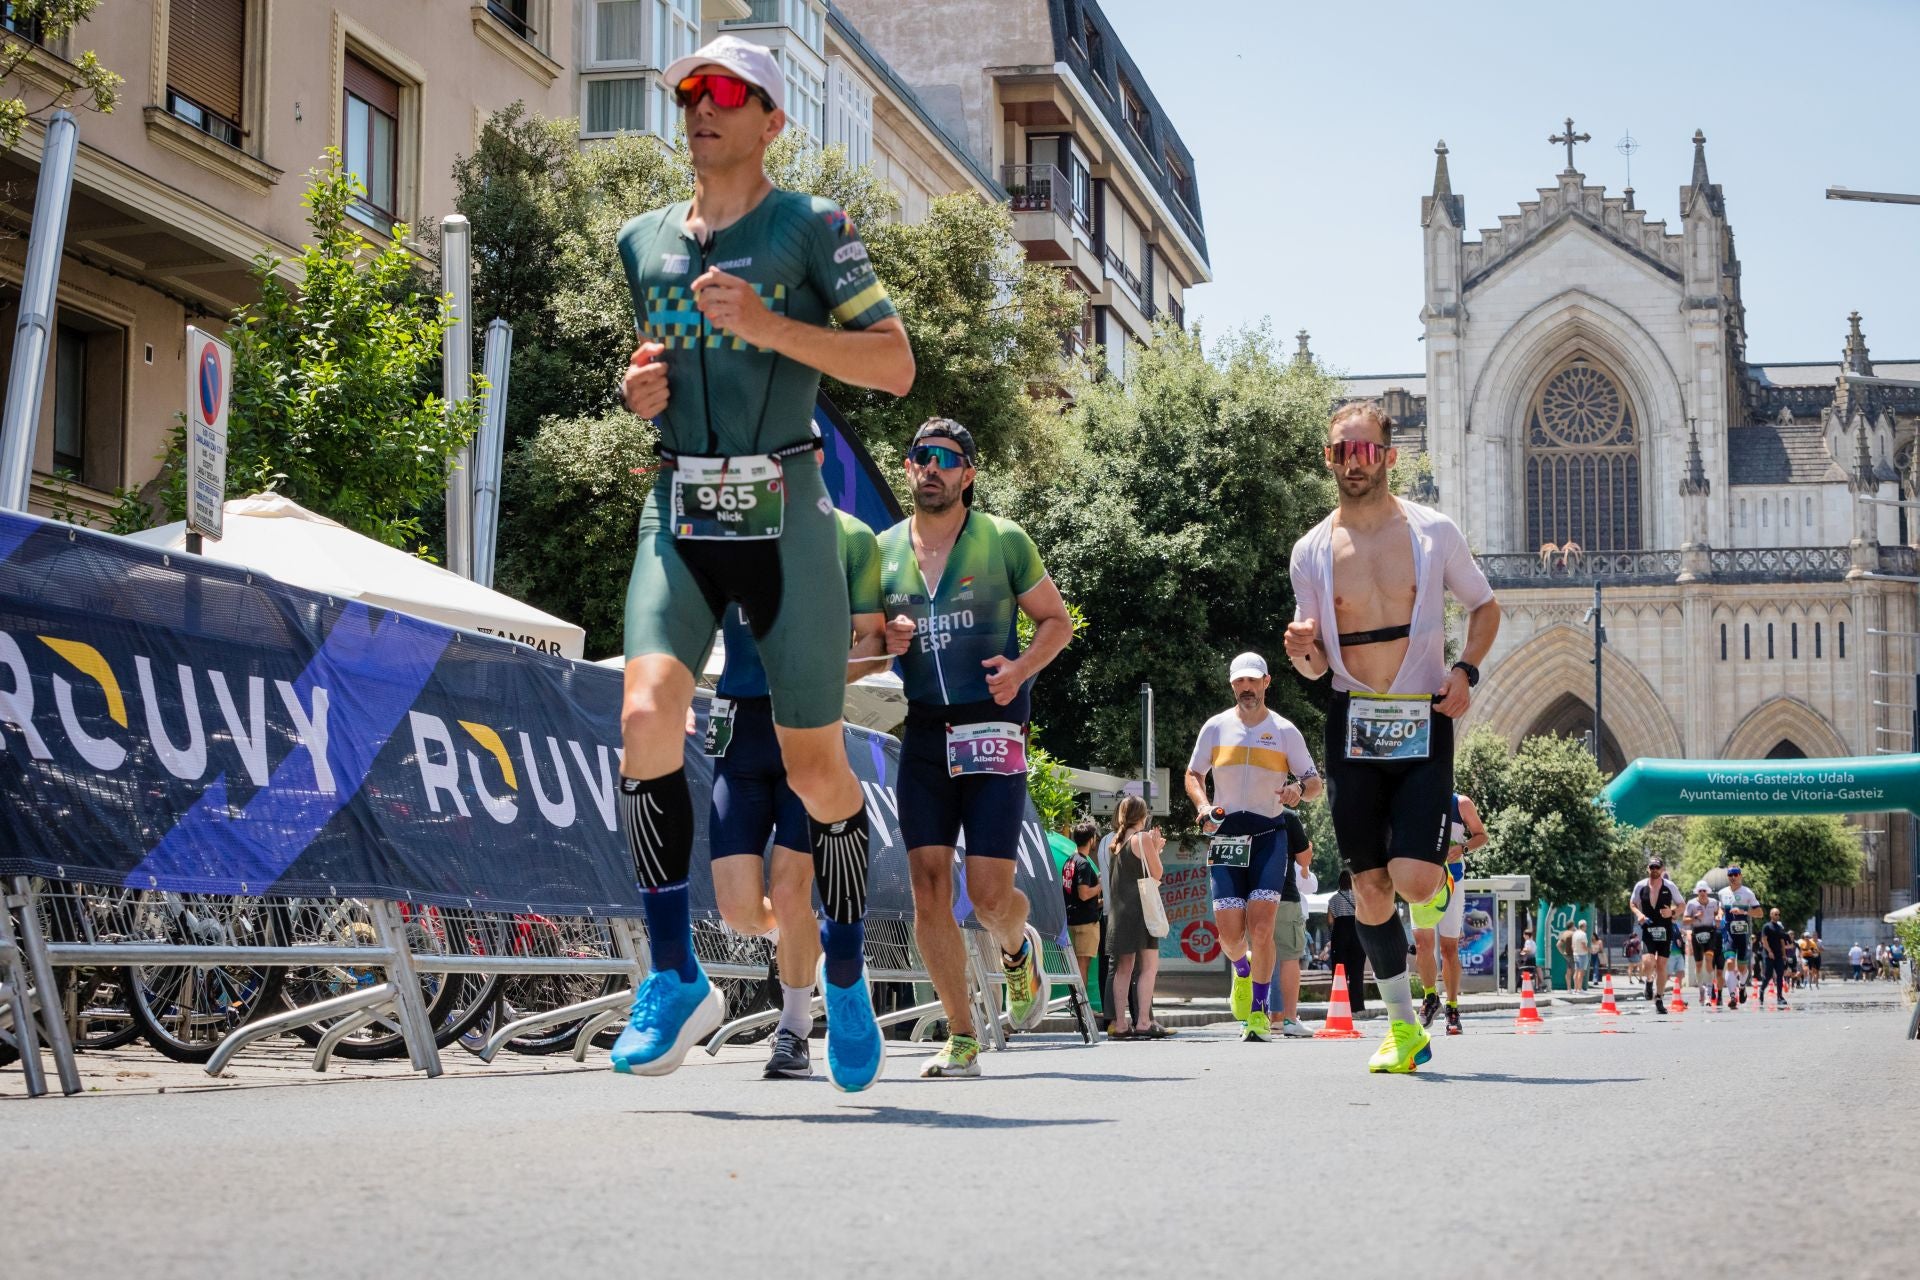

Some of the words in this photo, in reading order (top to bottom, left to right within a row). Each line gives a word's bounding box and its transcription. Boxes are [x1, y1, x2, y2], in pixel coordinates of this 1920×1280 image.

[697, 485, 757, 511] 965
[717, 511, 743, 522] Nick
[914, 610, 974, 636] BERTO
[920, 633, 952, 654] ESP
[1363, 721, 1417, 738] 1780
[968, 740, 1009, 756] 103
[409, 710, 624, 832] ROUV
[1707, 773, 1815, 785] Vitoria-Gasteizko
[1818, 772, 1855, 784] Udala
[1679, 788, 1768, 802] Ayuntamiento
[1772, 789, 1788, 800] de
[1791, 787, 1884, 800] Vitoria-Gasteiz
[1215, 845, 1243, 855] 1716
[1191, 934, 1211, 947] 50
